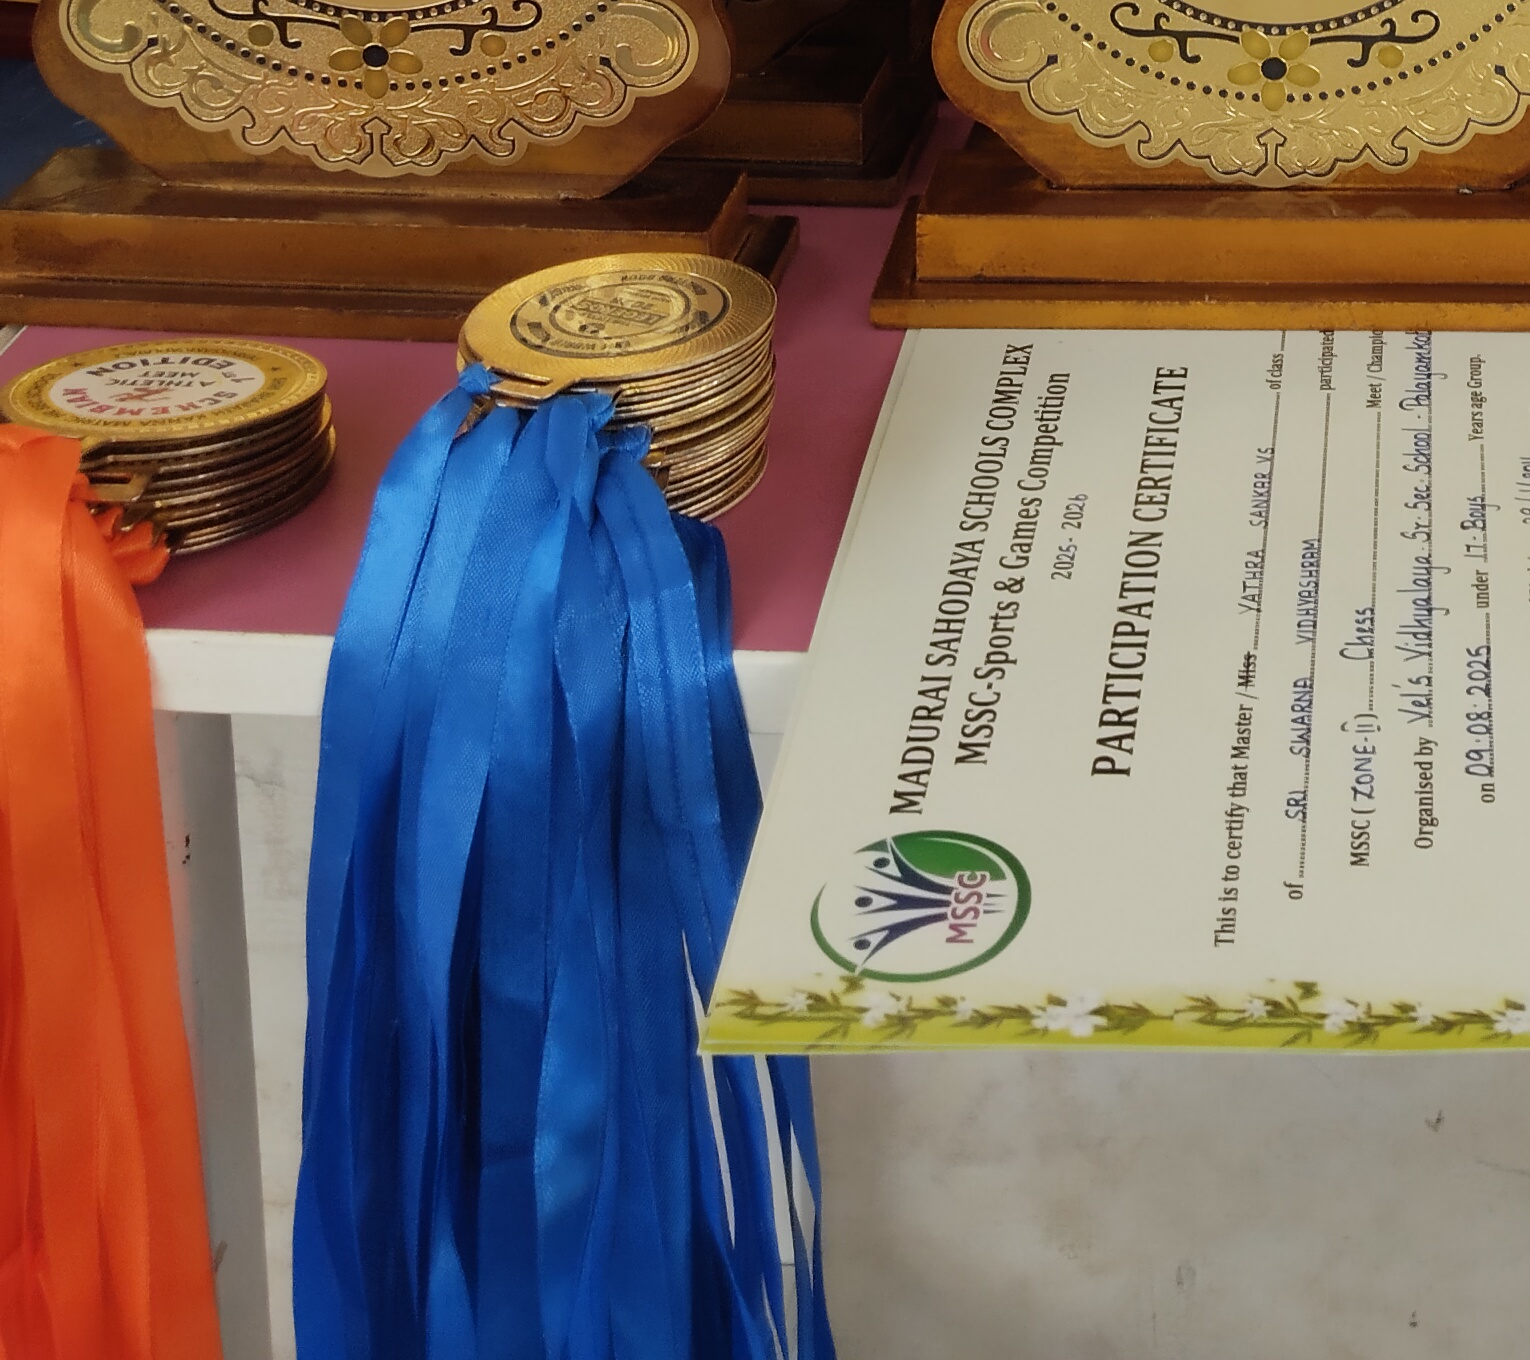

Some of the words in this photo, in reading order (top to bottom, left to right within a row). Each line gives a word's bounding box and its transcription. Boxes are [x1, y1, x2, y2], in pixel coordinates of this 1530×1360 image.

[85, 356, 234, 376] EDITION
[105, 379, 216, 389] ATHLETIC
[137, 370, 201, 379] MEET
[1015, 371, 1071, 492] Competition
[997, 496, 1043, 570] Games
[887, 674, 953, 815] MADURAI
[924, 537, 986, 667] SAHODAYA
[957, 435, 1010, 532] SCHOOLS
[984, 342, 1034, 431] COMPLEX
[992, 575, 1026, 594] &
[1090, 529, 1164, 777] PARTICIPATION
[1131, 365, 1189, 523] CERTIFICATE
[953, 599, 1020, 765] MSSC-Sports
[1230, 703, 1255, 760] Master
[1413, 735, 1439, 757] by
[1229, 763, 1250, 791] that
[1412, 760, 1439, 850] Organised
[1224, 793, 1250, 860] certify
[1348, 807, 1373, 867] MSSC
[1217, 886, 1239, 902] is
[1220, 863, 1241, 882] to
[944, 871, 987, 945] MSSC
[1212, 906, 1237, 948] This
